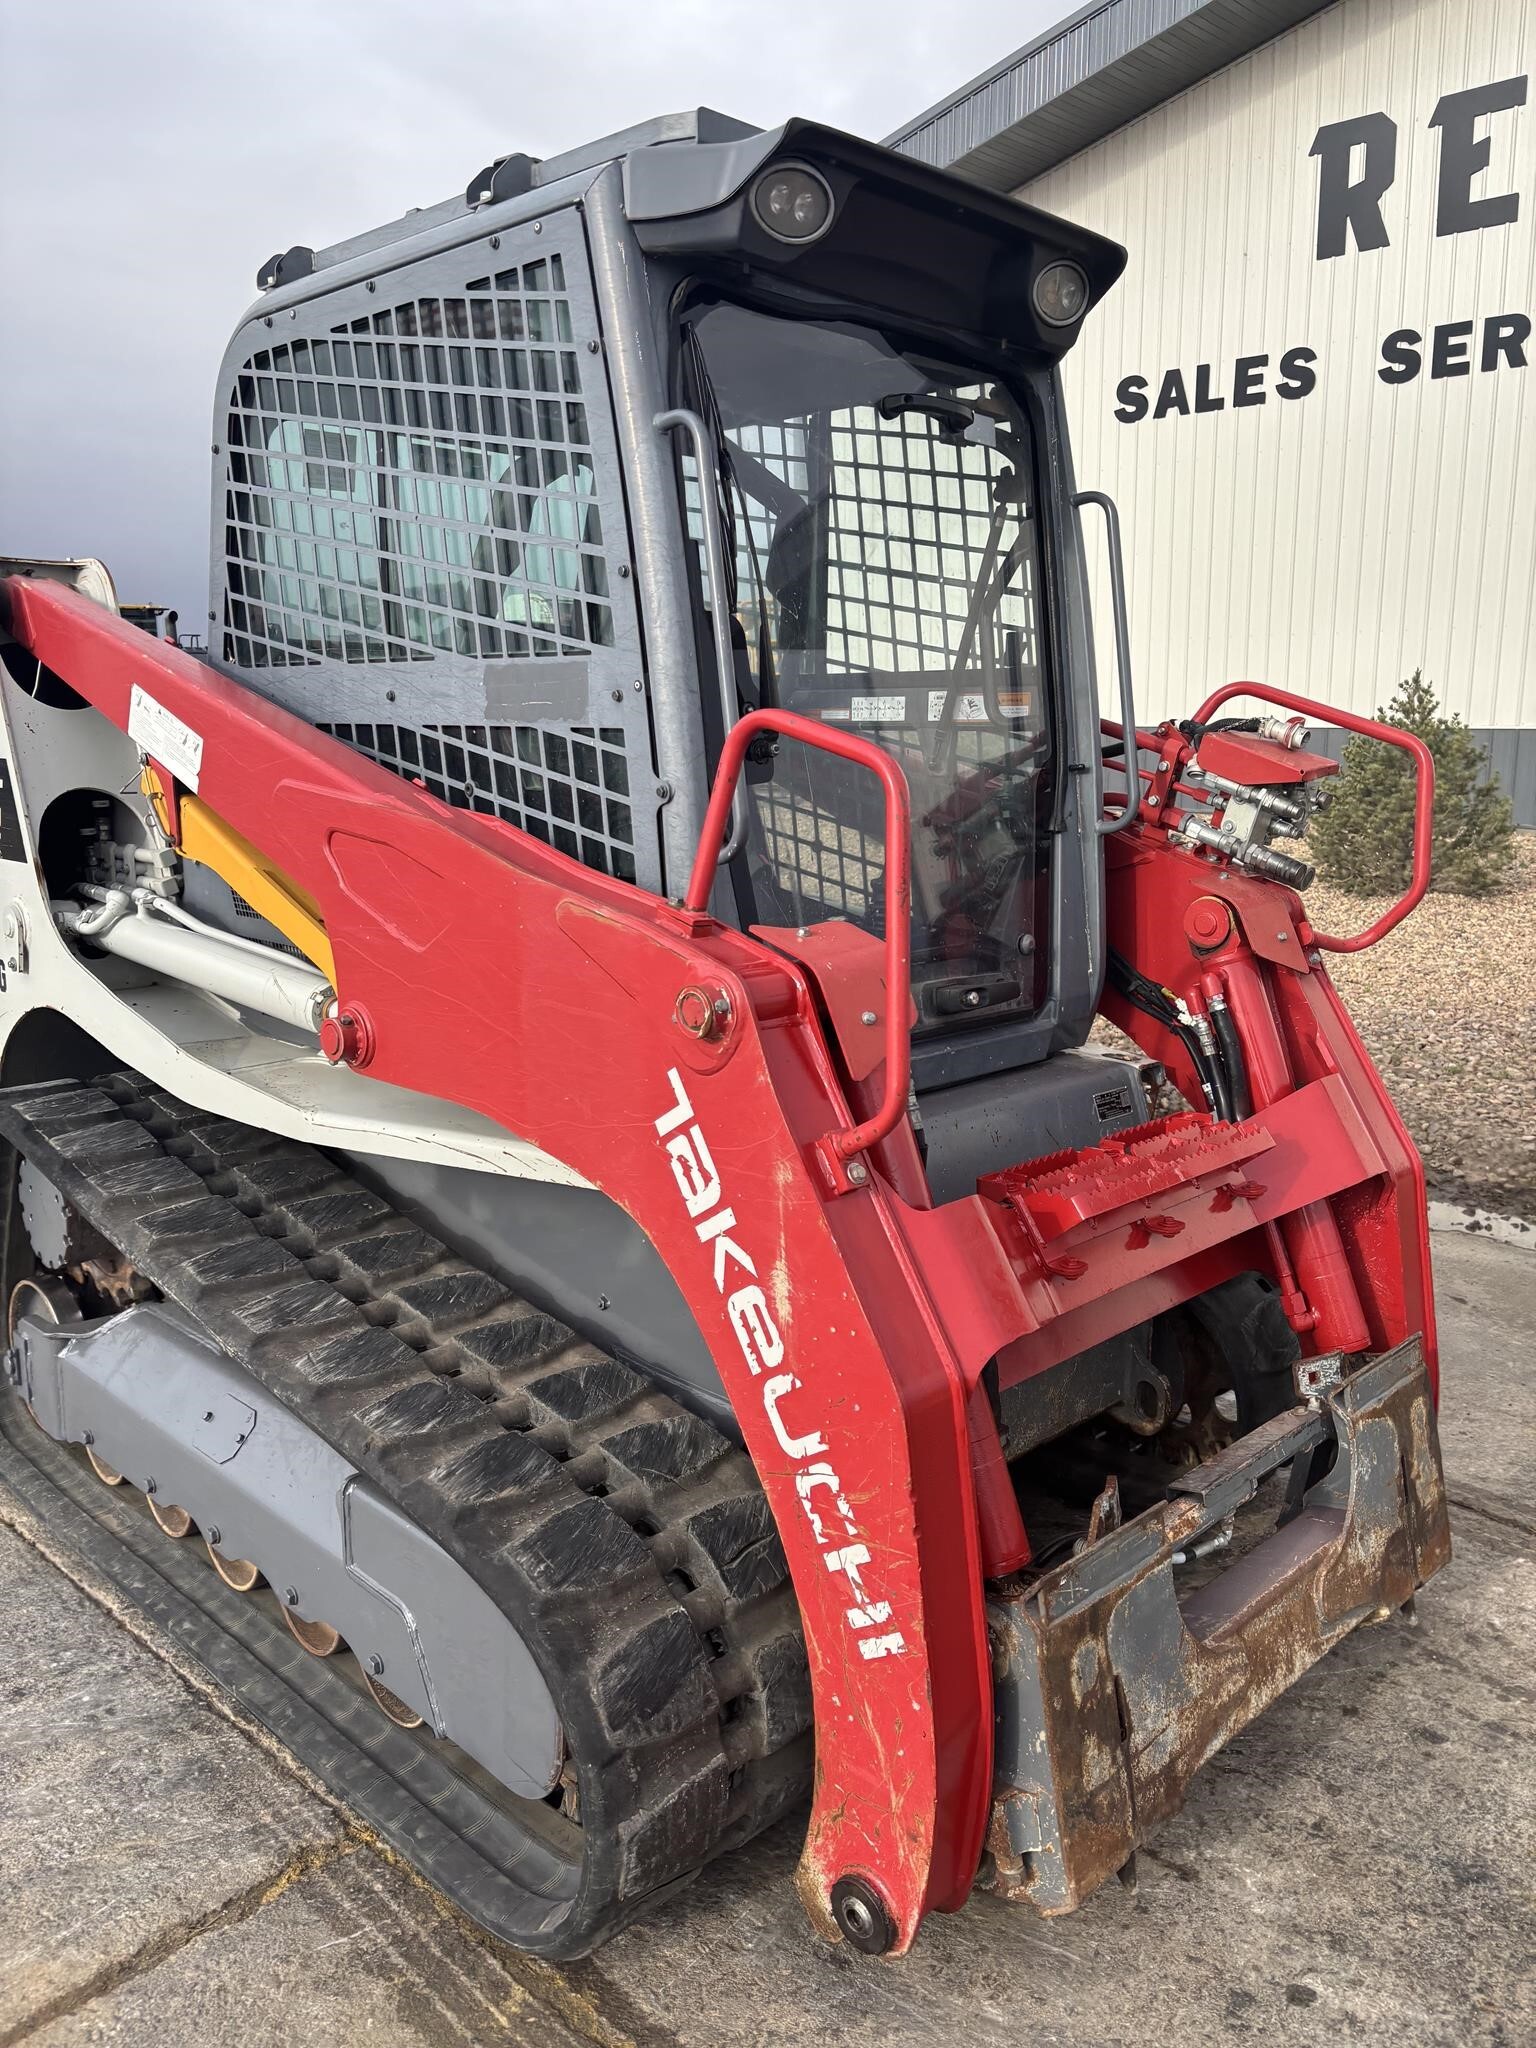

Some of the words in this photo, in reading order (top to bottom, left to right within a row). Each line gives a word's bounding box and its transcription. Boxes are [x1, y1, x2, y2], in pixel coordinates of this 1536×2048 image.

[1308, 75, 1528, 261] RE
[1113, 346, 1318, 424] SALES
[1377, 313, 1532, 385] SER
